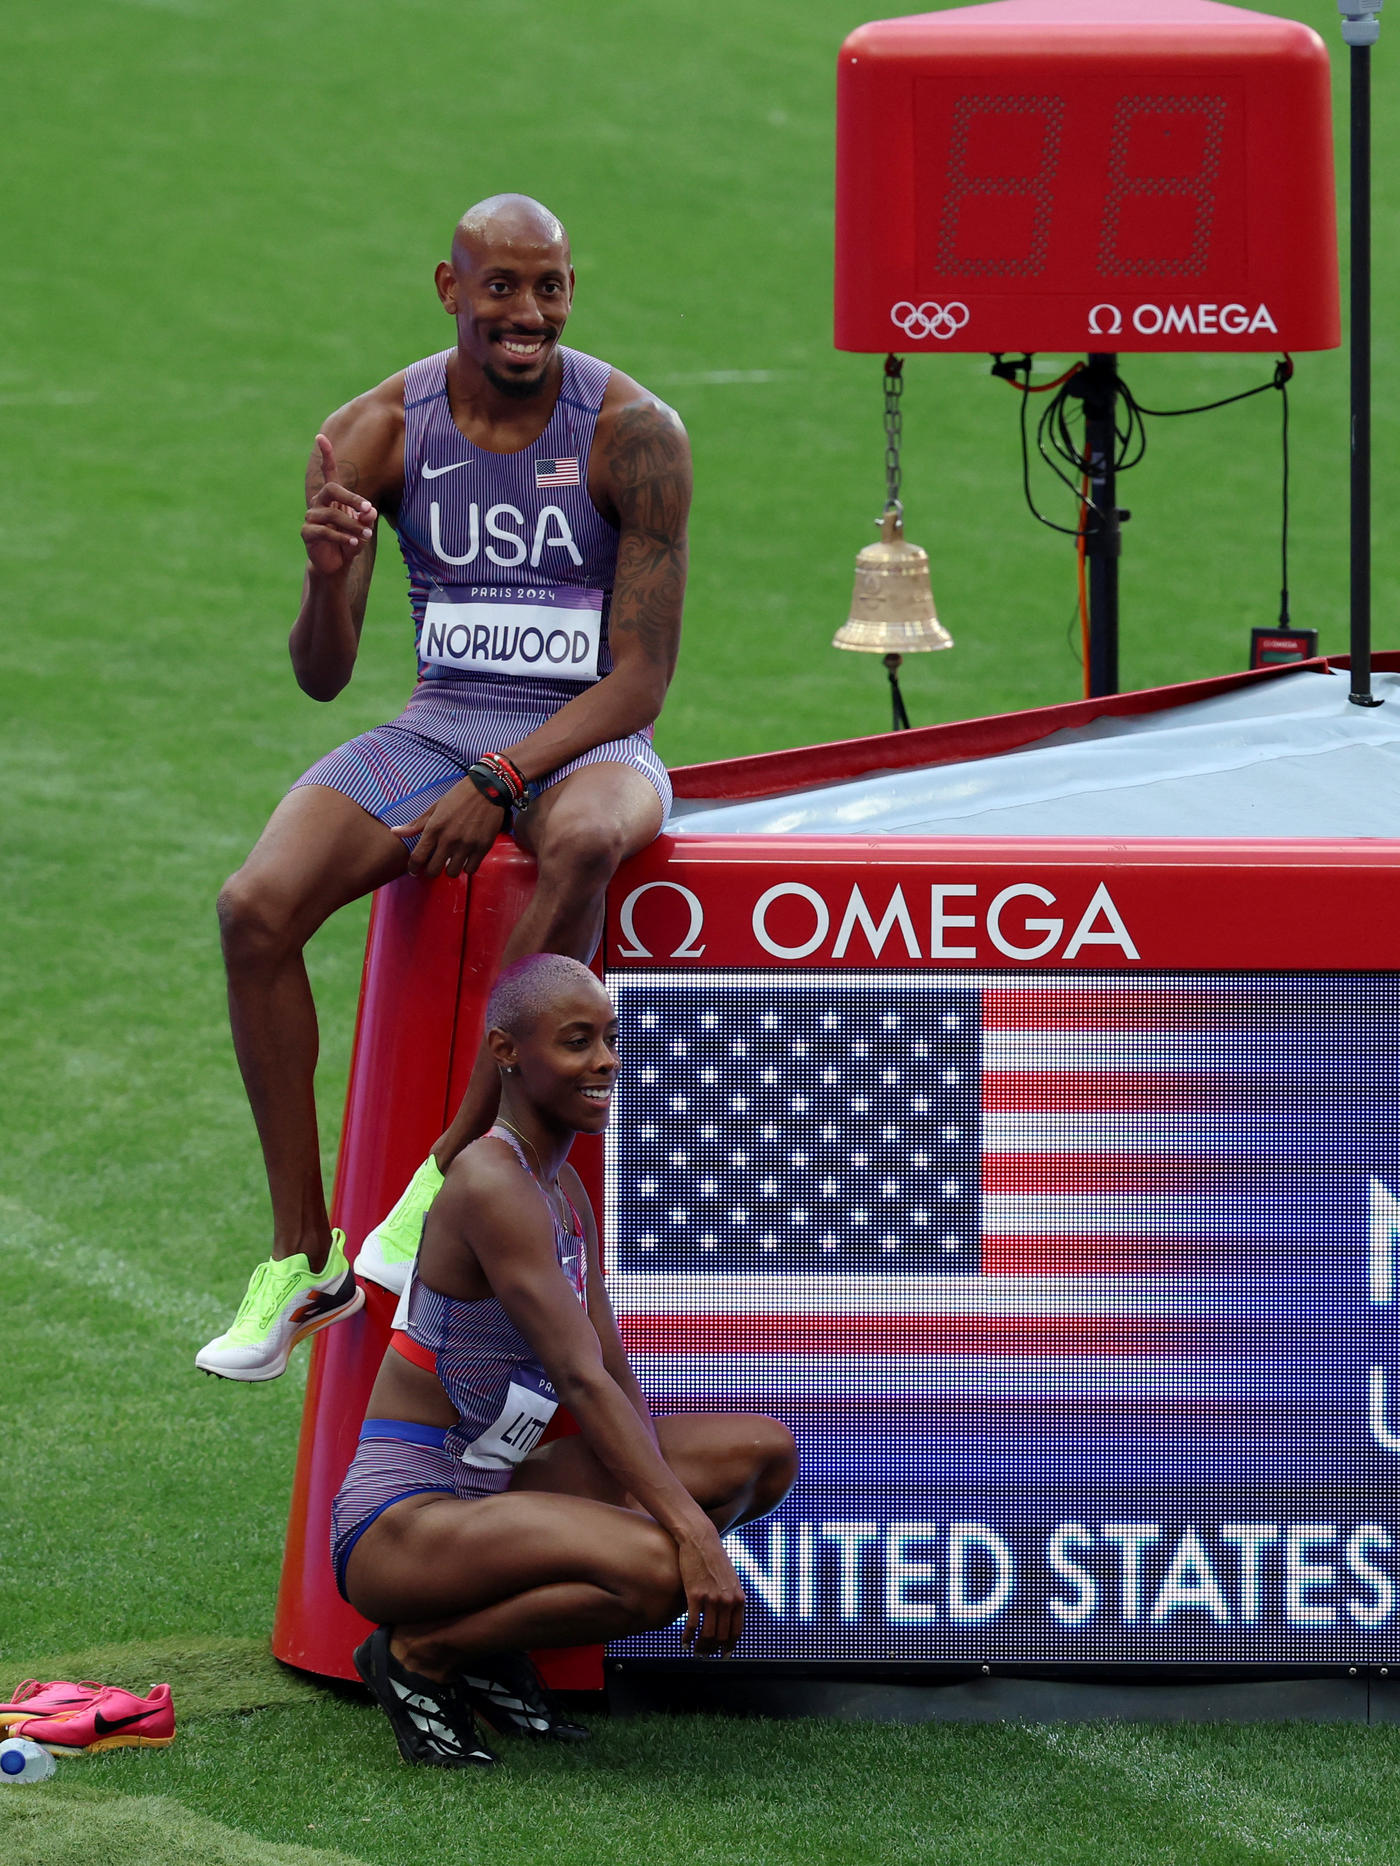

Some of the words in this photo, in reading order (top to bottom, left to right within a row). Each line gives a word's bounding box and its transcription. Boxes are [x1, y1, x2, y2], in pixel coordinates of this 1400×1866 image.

[1132, 303, 1278, 335] OMEGA
[430, 502, 583, 567] USA
[426, 622, 590, 664] NORWOOD
[752, 881, 1141, 961] OMEGA
[722, 1520, 1013, 1625] NITED
[1047, 1521, 1393, 1628] STATES
